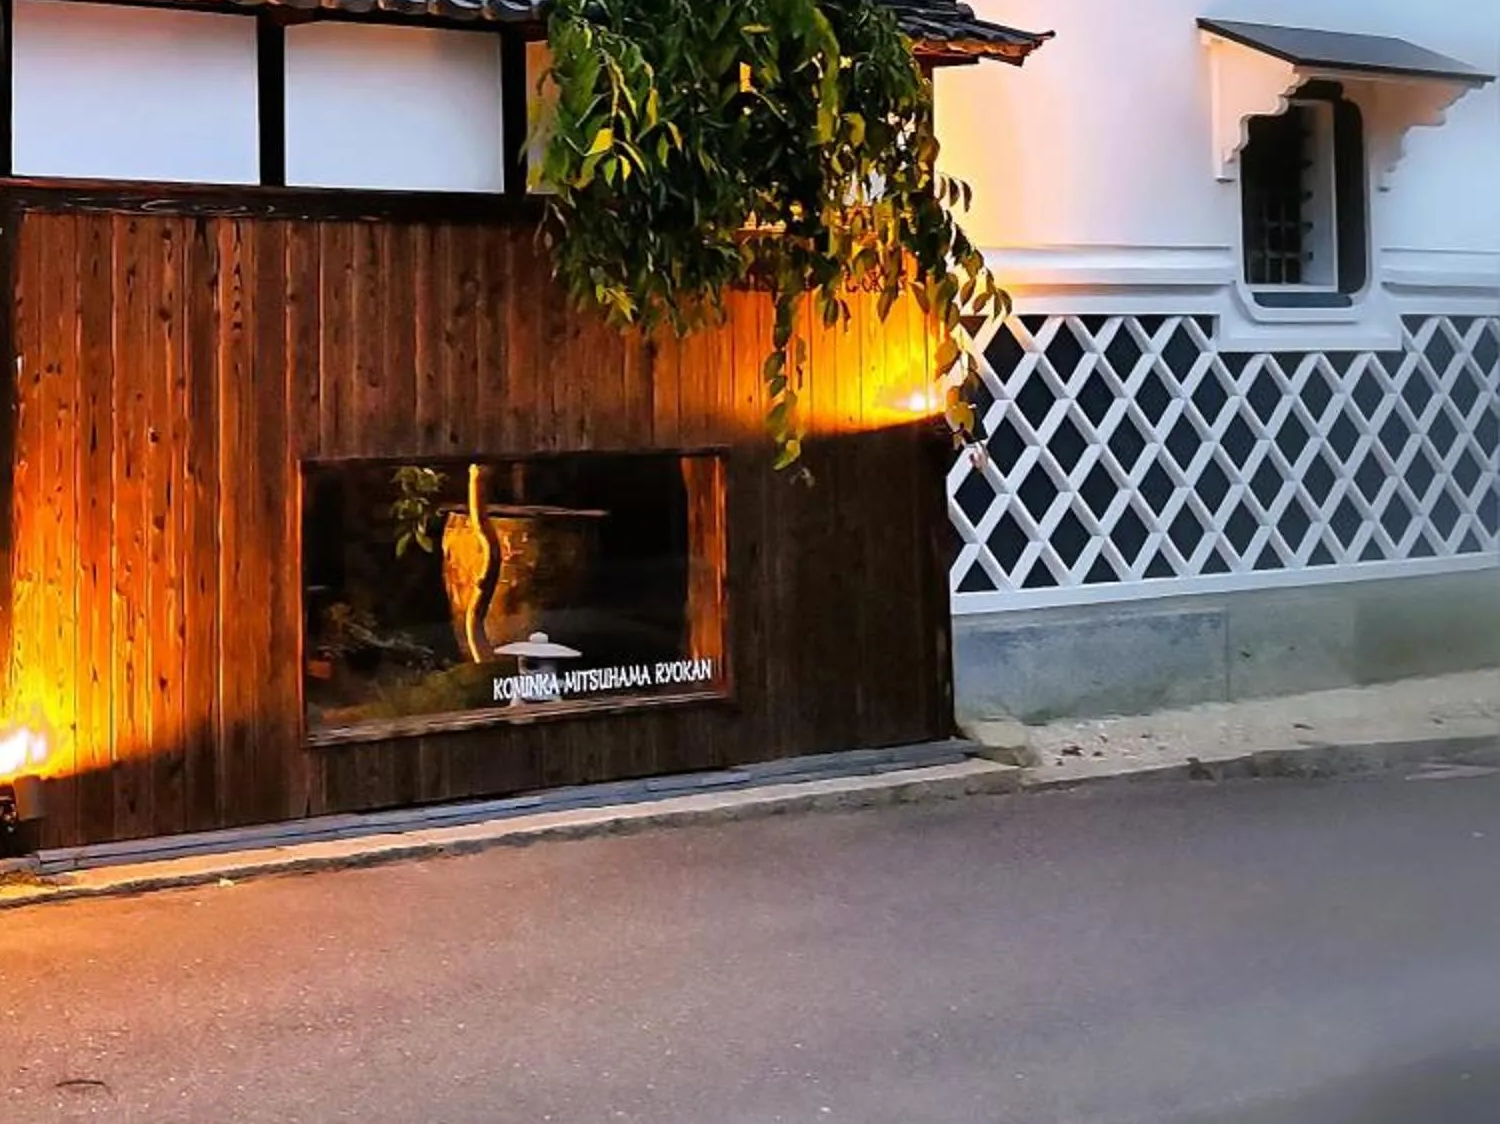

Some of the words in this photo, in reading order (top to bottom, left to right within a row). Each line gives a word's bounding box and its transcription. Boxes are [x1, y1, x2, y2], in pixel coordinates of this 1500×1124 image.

[493, 673, 560, 701] KOMINKA
[564, 663, 651, 694] MITSUHAMA
[655, 659, 712, 685] RYOKAN
